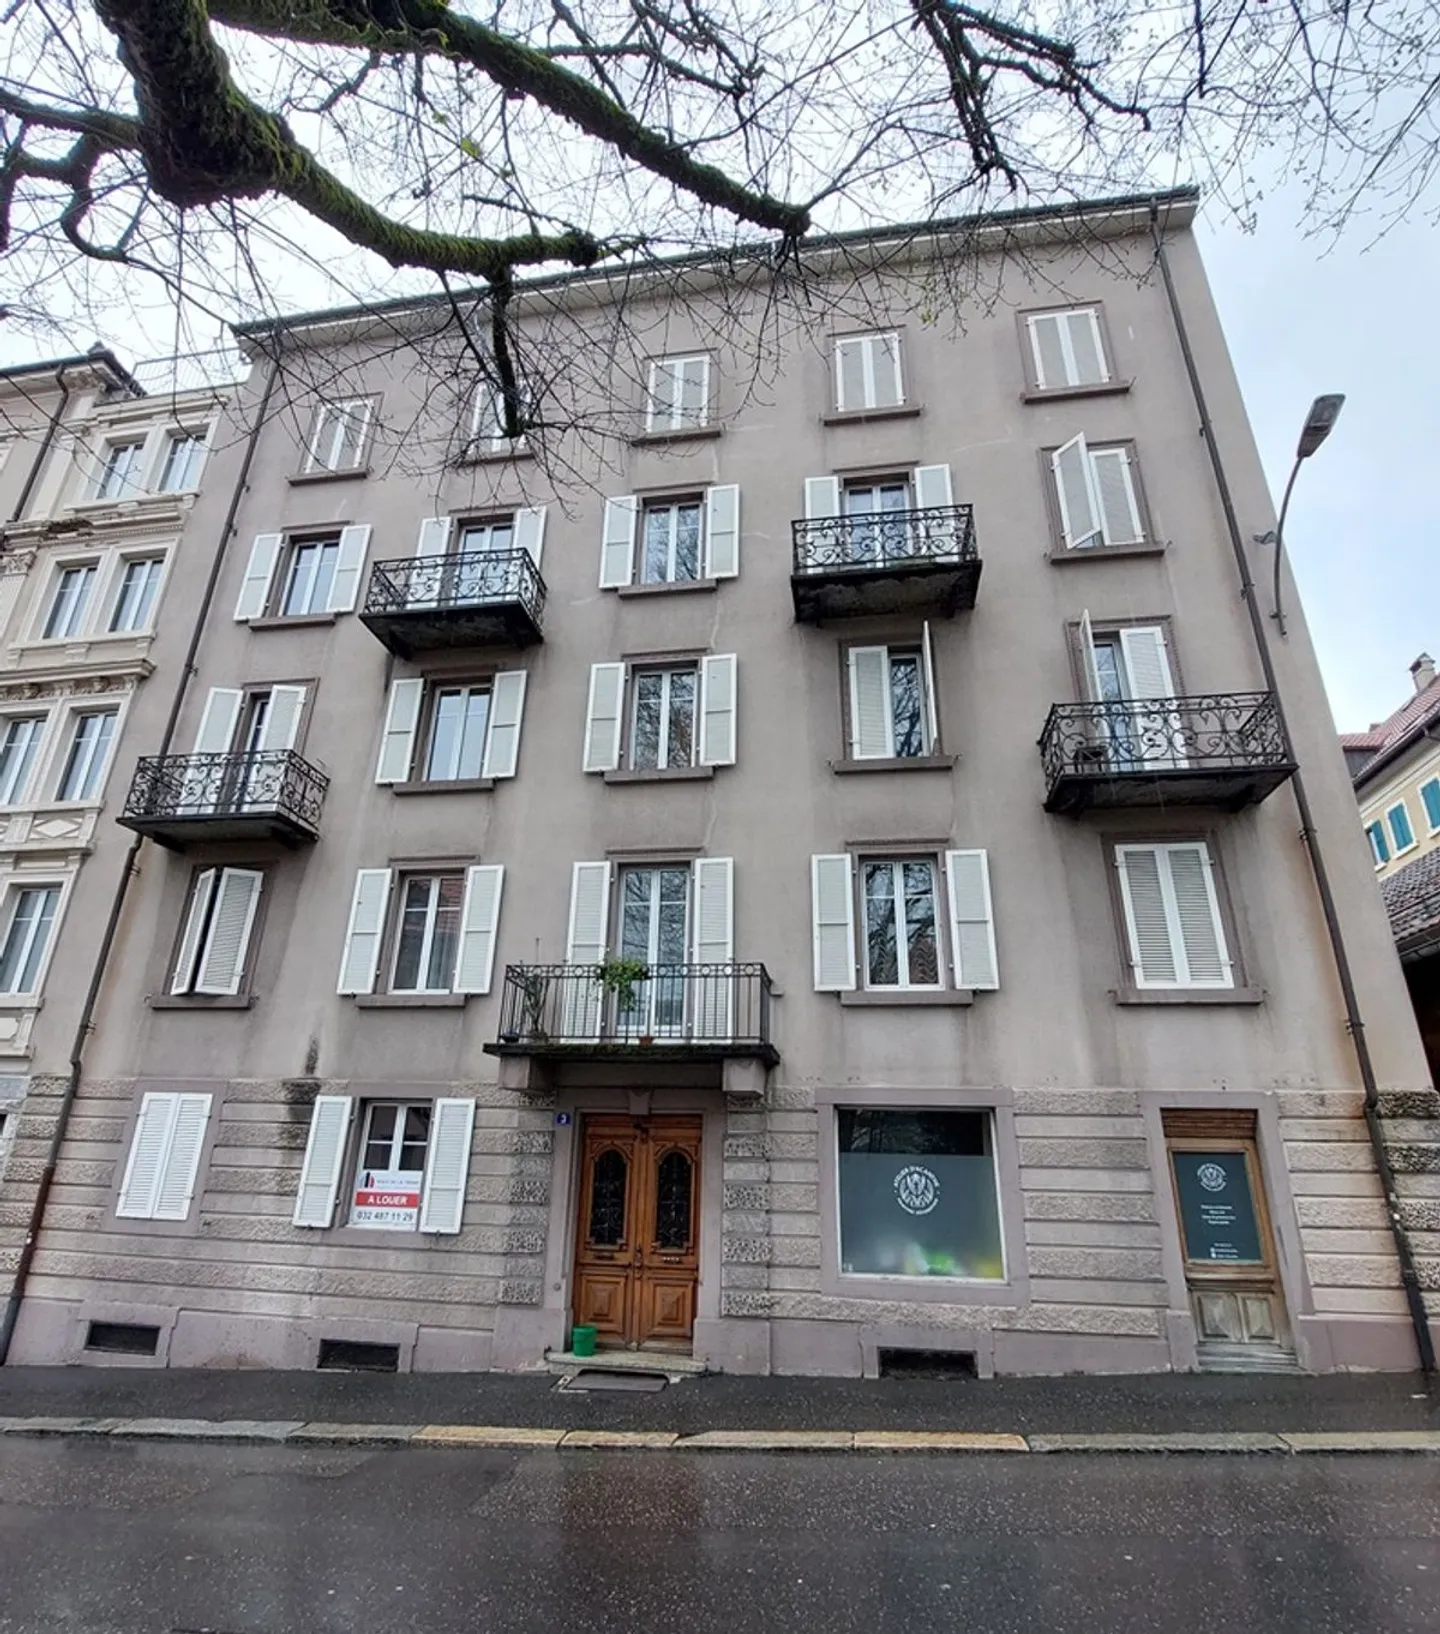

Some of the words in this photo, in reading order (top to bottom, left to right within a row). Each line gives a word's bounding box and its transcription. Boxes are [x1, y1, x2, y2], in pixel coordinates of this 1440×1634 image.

[367, 1195, 375, 1205] A
[376, 1195, 408, 1205] LOUER
[357, 1211, 372, 1220] 032
[374, 1211, 389, 1221] 487
[391, 1211, 401, 1221] 11
[403, 1211, 414, 1221] 29
